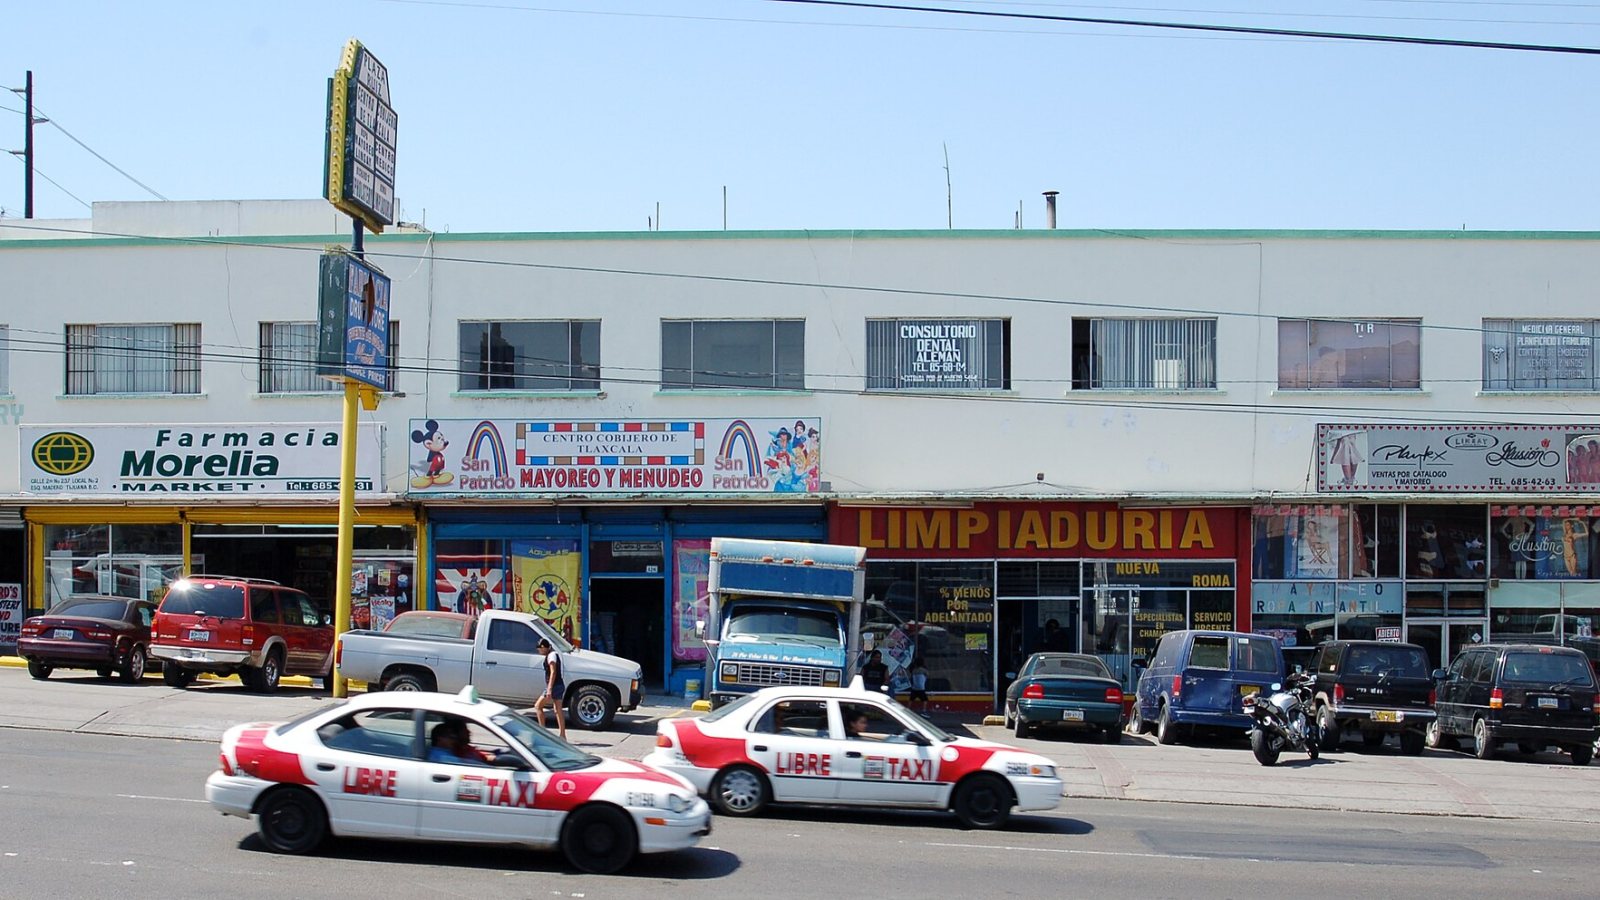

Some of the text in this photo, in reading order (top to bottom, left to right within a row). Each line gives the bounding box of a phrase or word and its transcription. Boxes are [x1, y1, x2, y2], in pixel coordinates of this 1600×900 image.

[364, 53, 386, 85] PLAZA
[900, 324, 976, 339] CONSULTORIO
[1522, 324, 1585, 335] MEDICINA GENERAL
[916, 339, 960, 352] DENTAL
[916, 351, 961, 363] ALEMAN
[155, 428, 339, 447] Farmacia
[543, 434, 677, 443] CENTRO COBIJERO DE
[577, 445, 643, 454] TLAXCALA
[120, 450, 280, 477] Morelia
[461, 456, 490, 472] San
[714, 456, 744, 472] San
[520, 467, 703, 488] MAYOREO Y MENUDEO
[1371, 471, 1447, 479] VENTAS POR CATALOGO
[121, 482, 253, 492] MARKET
[460, 474, 515, 489] Patricio
[712, 473, 769, 490] Patricio
[1400, 478, 1431, 486] MAYOREO
[1489, 478, 1556, 486] TEL. 685-42-63
[858, 510, 1215, 550] LIMPIADURIA
[1115, 562, 1160, 575] NUEVA
[1192, 575, 1231, 587] ROMA
[953, 588, 991, 599] MENOS
[947, 600, 969, 611] POR
[925, 612, 992, 623] ADELANTADO
[1135, 613, 1184, 622] ESPECIALISTAS
[1194, 612, 1232, 622] SERVICIO
[1155, 622, 1165, 630] EN
[1377, 628, 1400, 638] ABIERTO
[1133, 648, 1147, 656] PIEL
[775, 751, 831, 776] LIBRE
[888, 758, 933, 781] TAXI
[343, 766, 399, 798] LIBRE
[485, 777, 538, 809] TAXI
